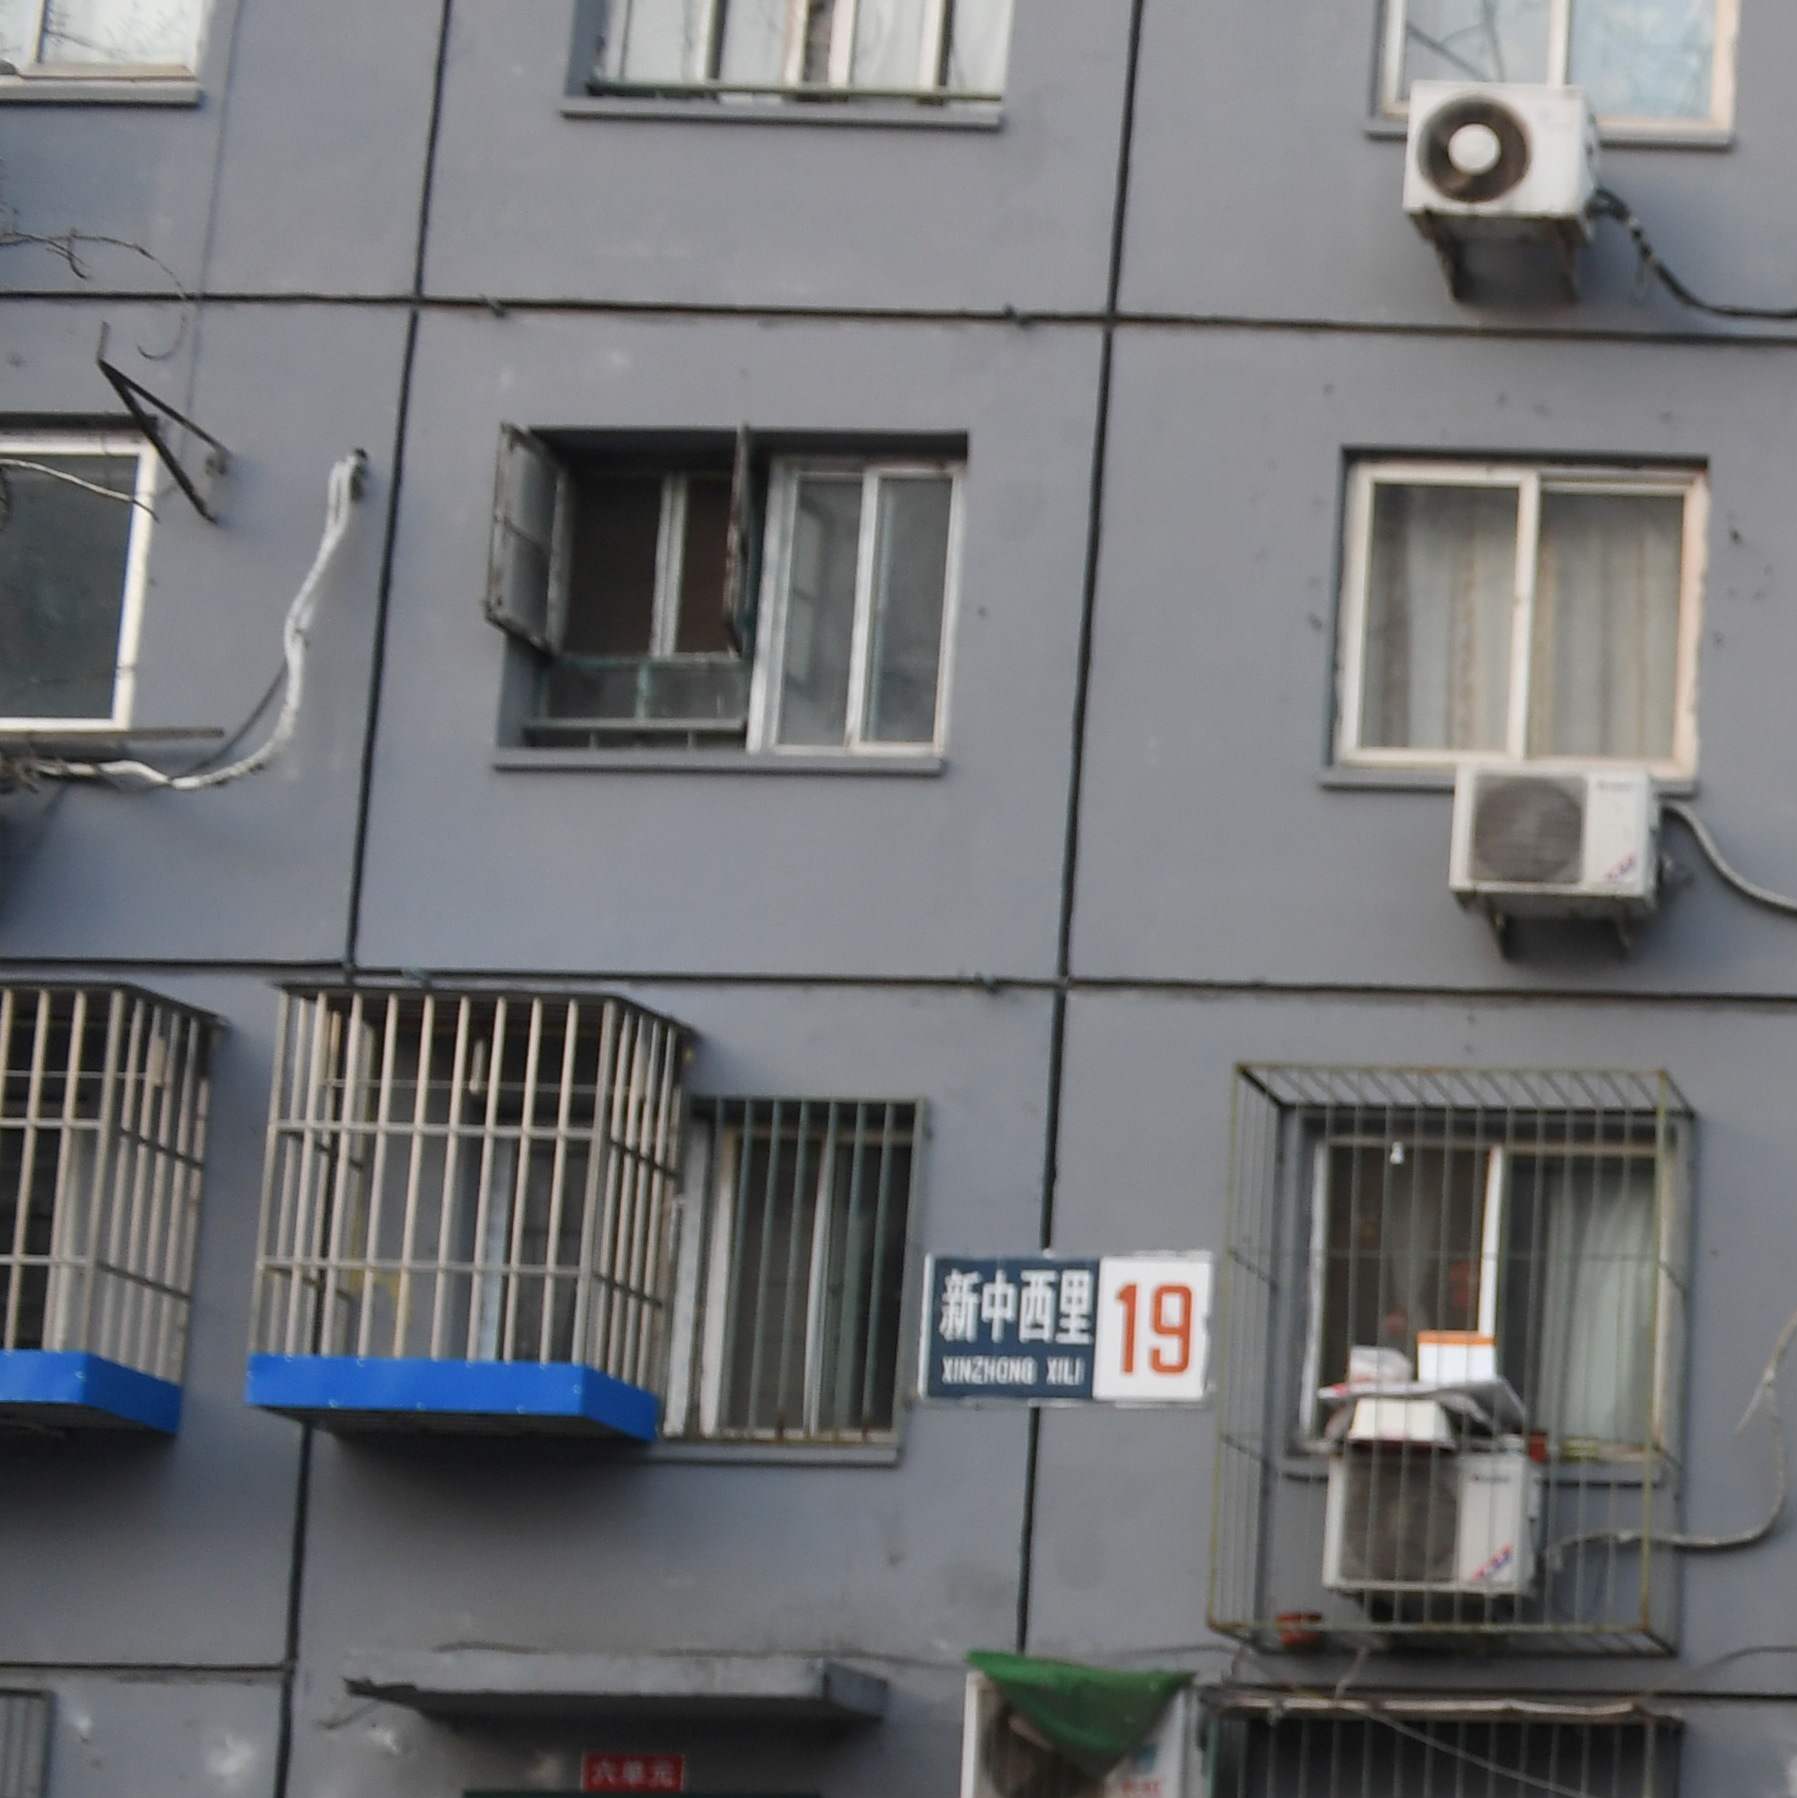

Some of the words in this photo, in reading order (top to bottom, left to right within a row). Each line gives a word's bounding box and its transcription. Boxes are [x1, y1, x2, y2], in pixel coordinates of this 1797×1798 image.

[939, 1269, 1094, 1344] 新中西里
[1116, 1283, 1192, 1375] 19
[942, 1356, 1037, 1385] XINZHONG
[1047, 1356, 1085, 1385] XILI
